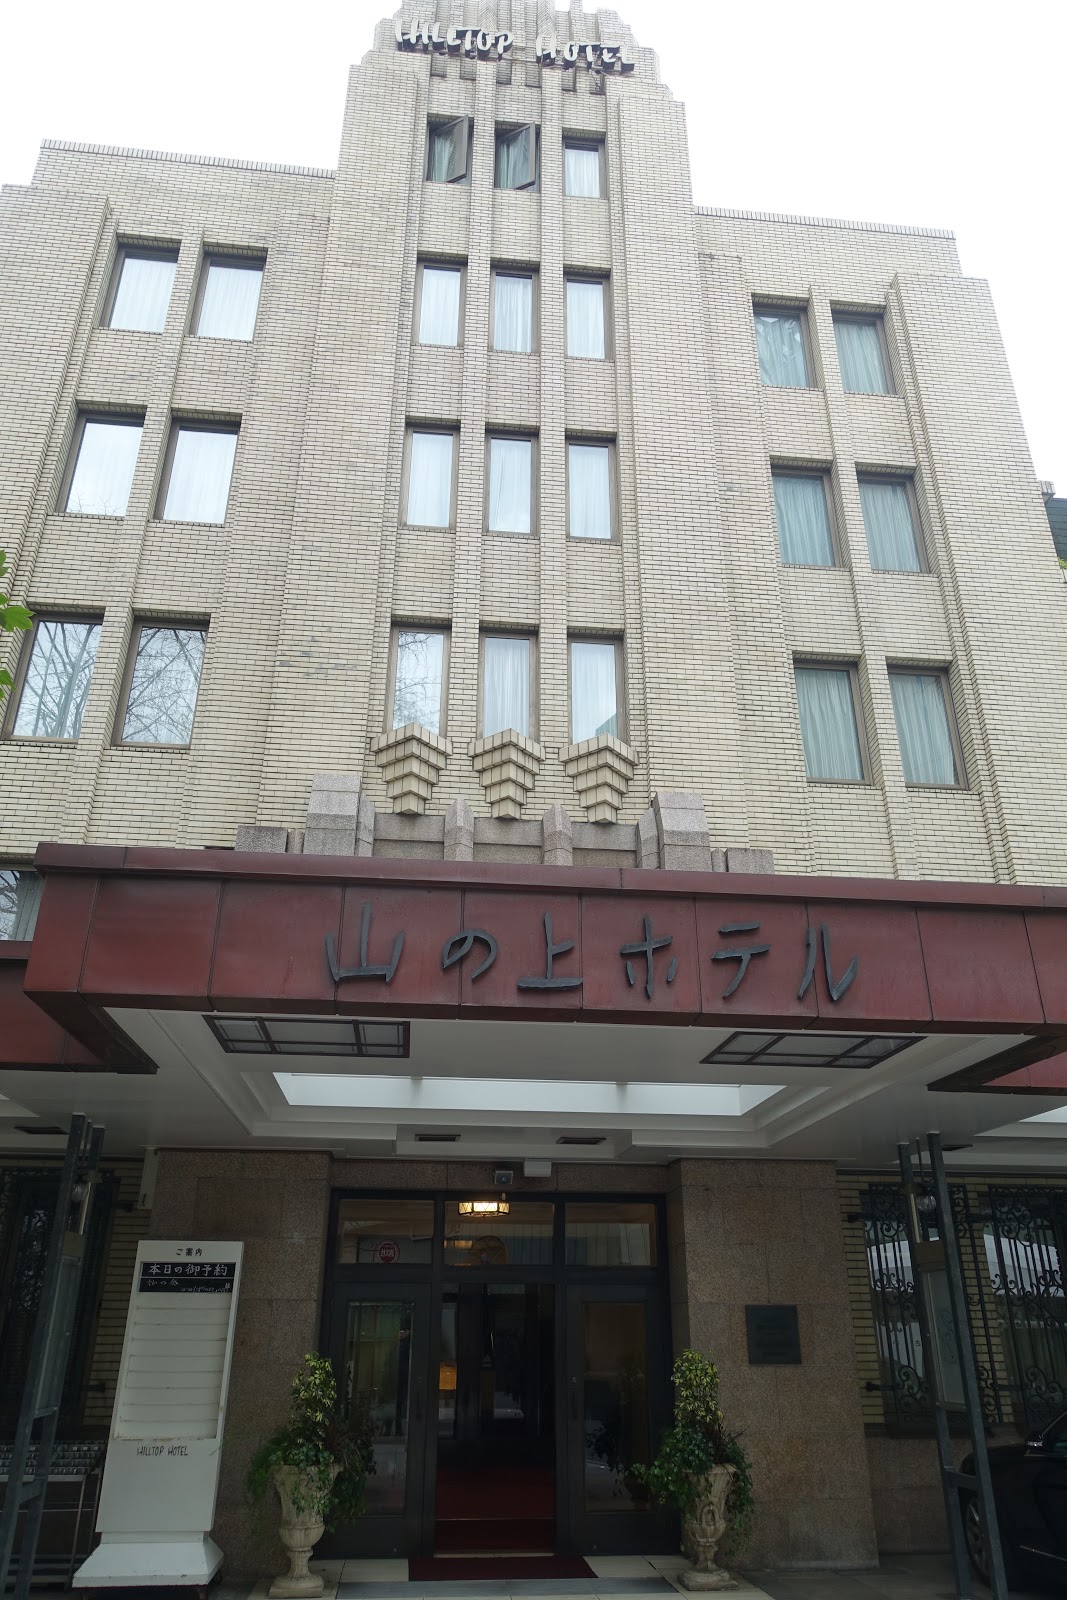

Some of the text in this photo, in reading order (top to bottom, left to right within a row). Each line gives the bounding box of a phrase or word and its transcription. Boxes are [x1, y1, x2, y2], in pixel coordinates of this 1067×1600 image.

[395, 19, 635, 71] HILLTOP HOTEL
[326, 903, 858, 1000] 山の上ホテル
[176, 1247, 203, 1257] ご案内
[148, 1263, 228, 1277] 本日の御予約
[137, 1445, 189, 1456] HILLTOP HOTEL
